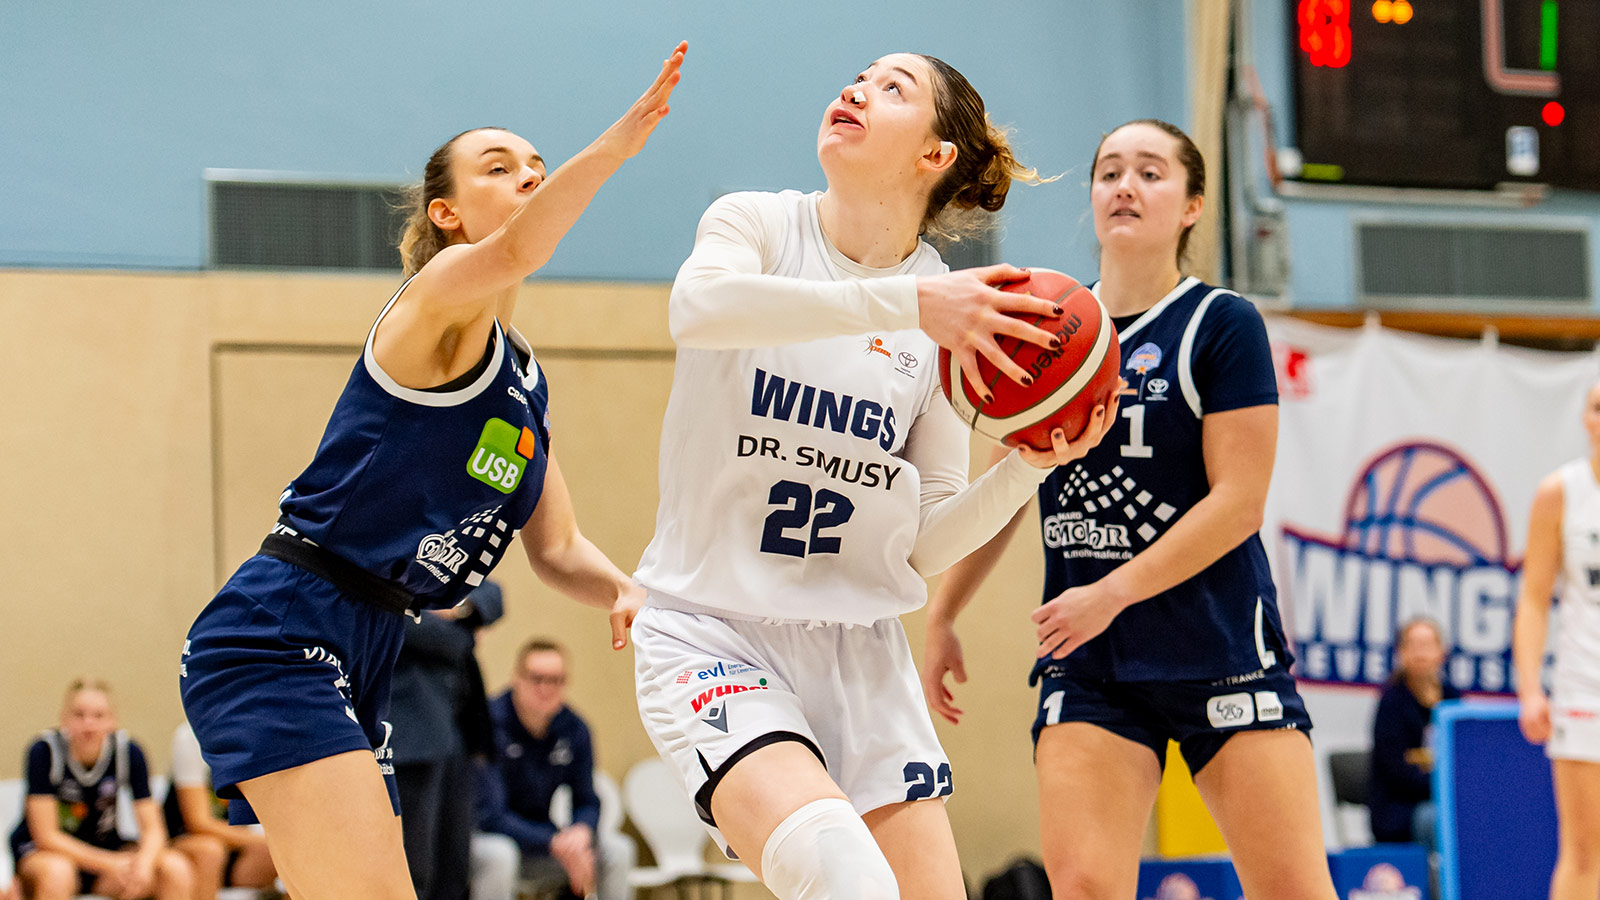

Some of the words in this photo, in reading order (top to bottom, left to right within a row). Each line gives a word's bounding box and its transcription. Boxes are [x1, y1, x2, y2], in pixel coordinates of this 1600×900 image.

[751, 368, 896, 452] WINGS
[1120, 404, 1153, 458] 1
[472, 447, 519, 489] USB
[737, 434, 787, 461] DR.
[795, 446, 901, 490] SMUSY
[760, 479, 855, 558] 22
[1284, 541, 1512, 652] WING
[698, 661, 726, 680] evl
[1043, 690, 1066, 726] 1
